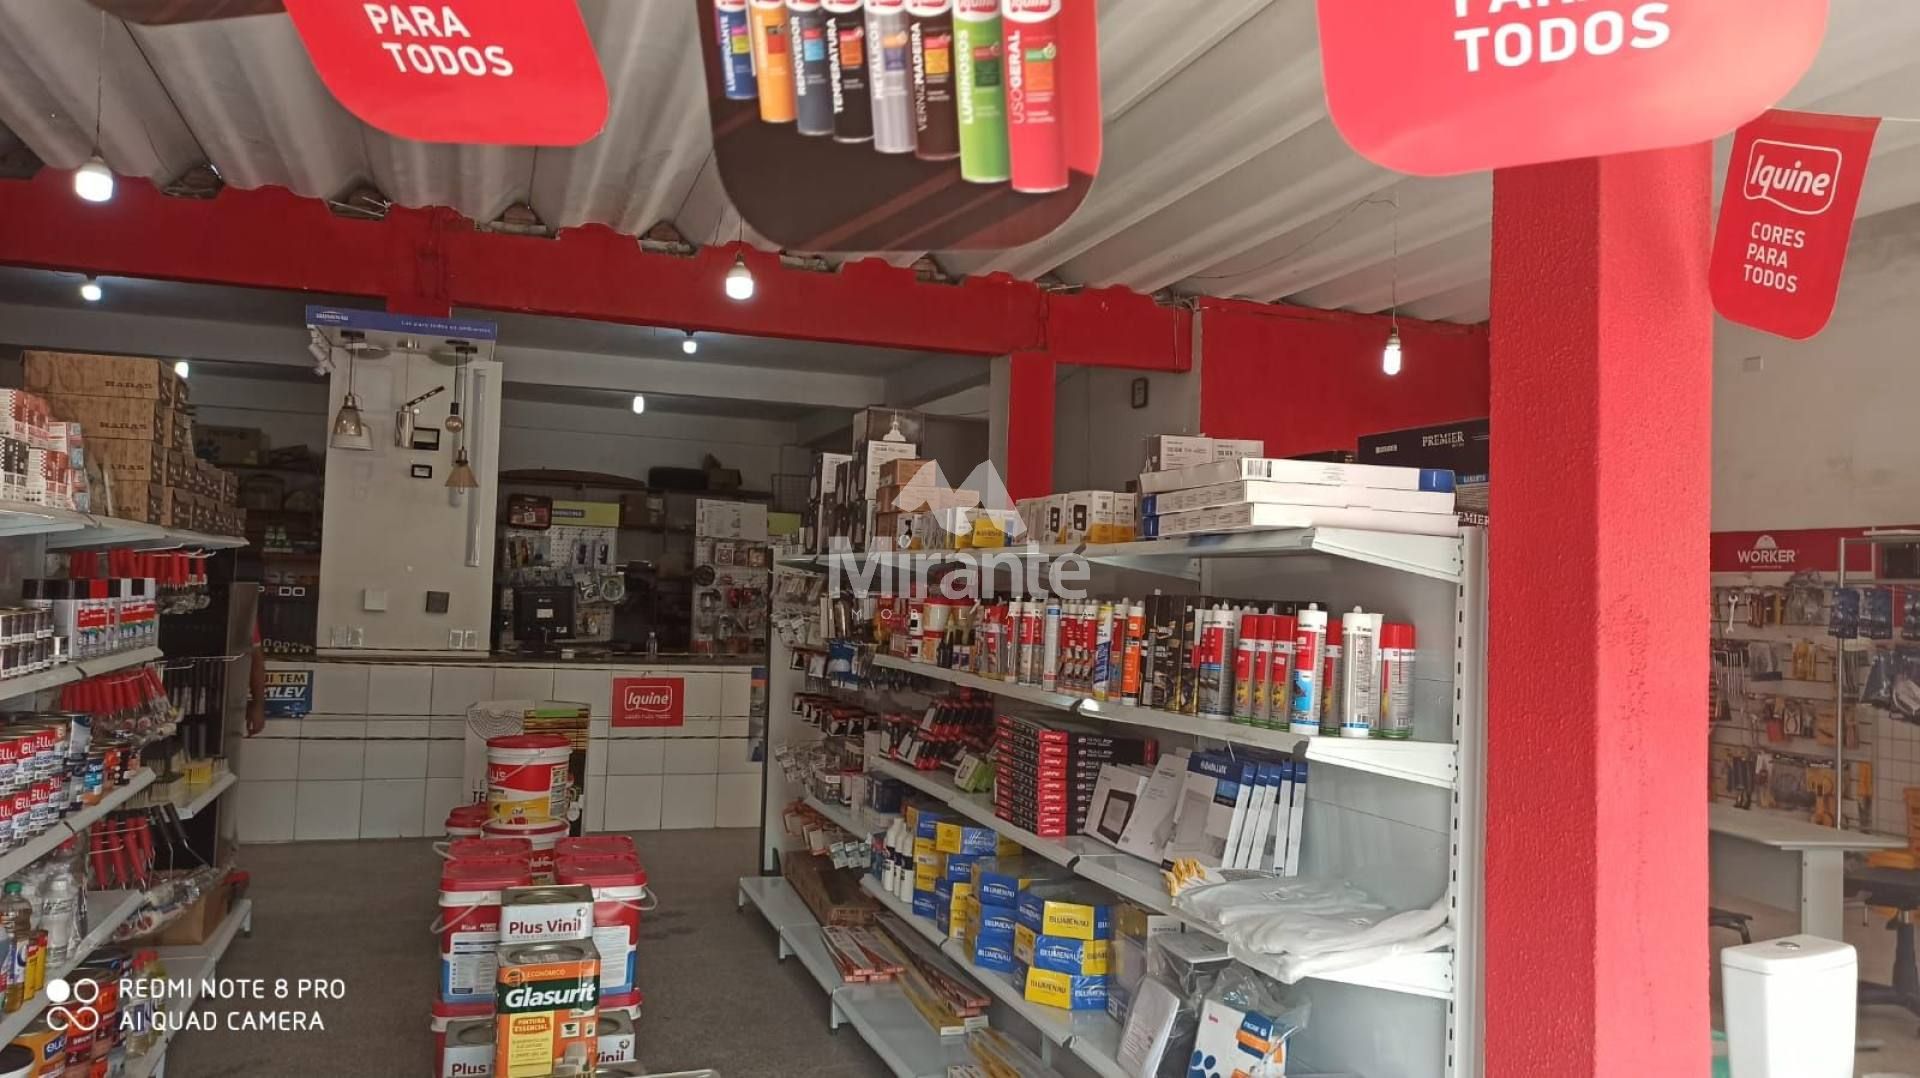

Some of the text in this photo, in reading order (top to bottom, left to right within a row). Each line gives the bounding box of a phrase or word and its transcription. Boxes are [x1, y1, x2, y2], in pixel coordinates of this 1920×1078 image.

[363, 3, 471, 38] PARA
[1454, 2, 1671, 72] TODOS
[382, 42, 514, 77] TODOS
[958, 29, 973, 125] LUMINOSOS
[1750, 155, 1830, 197] Iquine
[1751, 222, 1805, 248] CORES
[1747, 243, 1788, 269] PARA
[1744, 264, 1798, 293] TODOS
[1422, 431, 1464, 447] PREMIER
[1737, 549, 1796, 563] WORKER
[279, 673, 306, 683] TEM
[628, 692, 669, 709] Iquine
[509, 918, 581, 935] Plus Vinil
[1048, 915, 1089, 927] BLUMENAU
[978, 949, 1011, 961] BLUMENAU
[1040, 949, 1079, 961] BLUMENAU
[505, 982, 596, 1008] Glasurit
[1030, 980, 1067, 993] BLUMENAU
[452, 1063, 487, 1076] Plus
